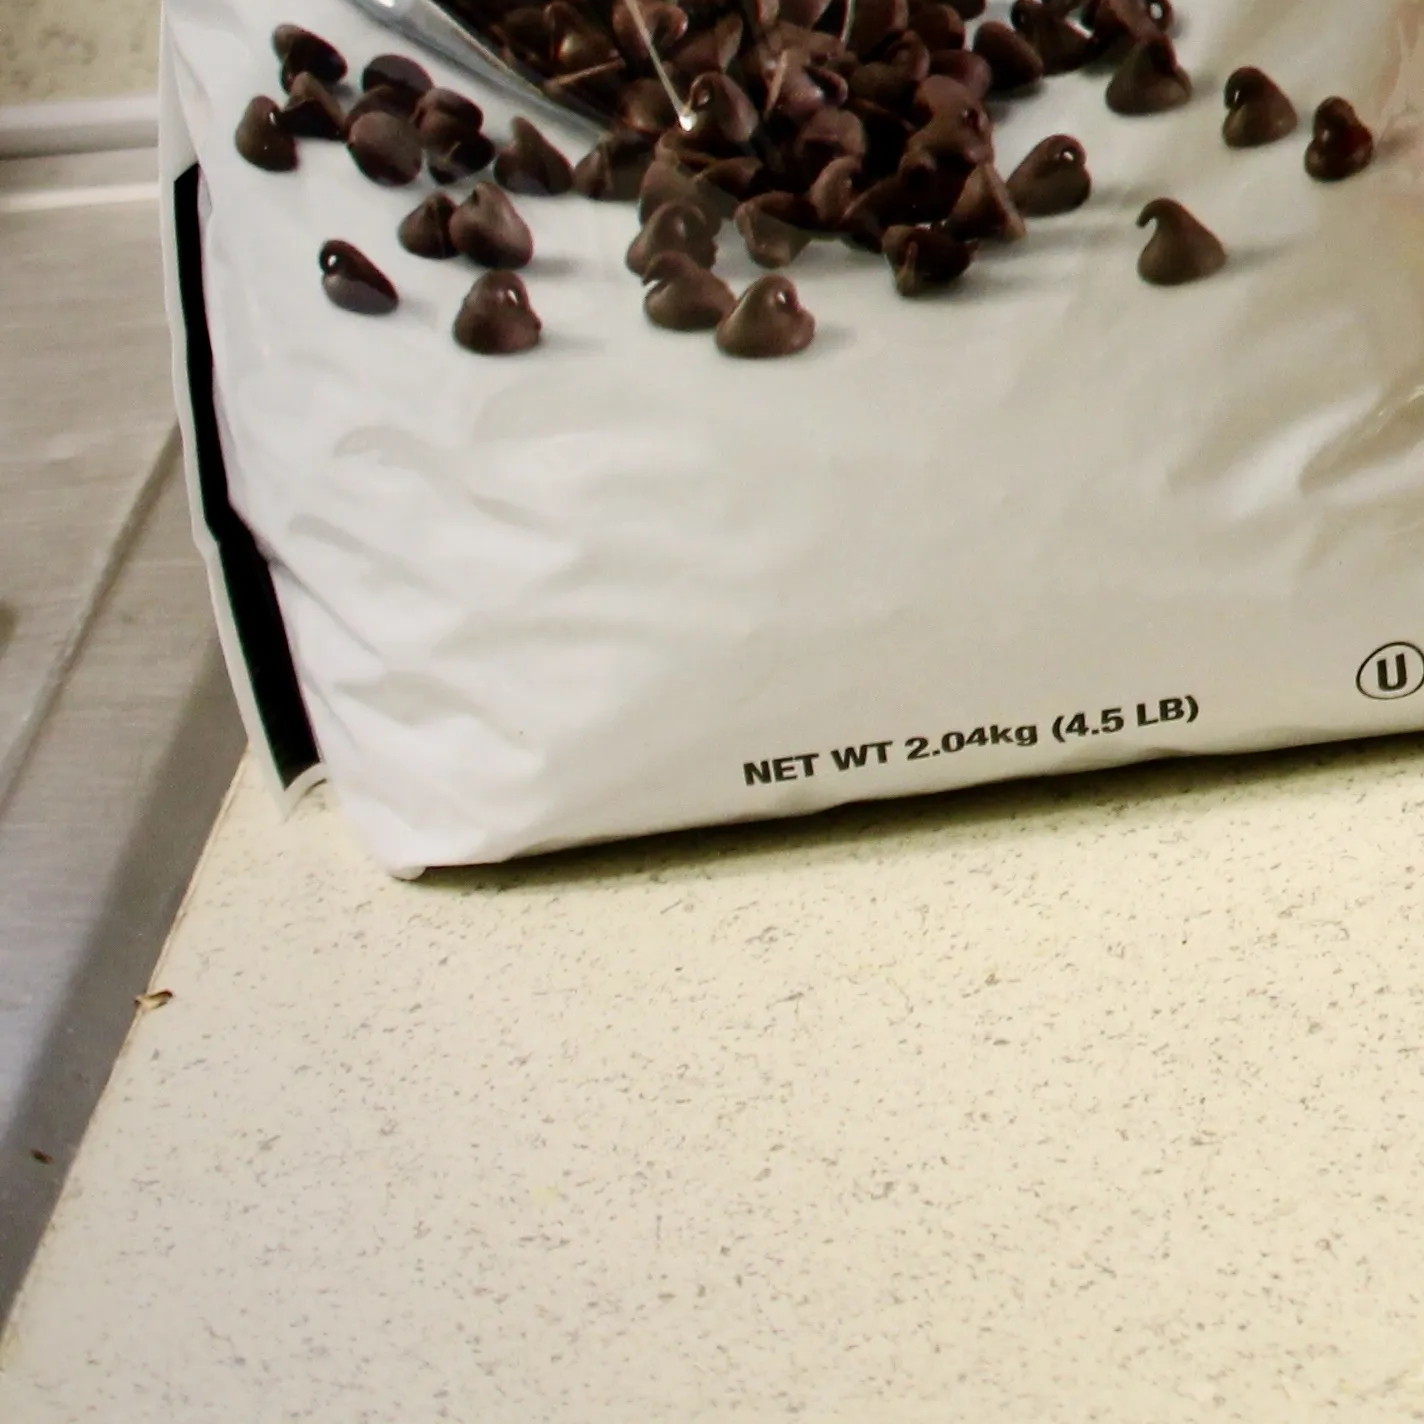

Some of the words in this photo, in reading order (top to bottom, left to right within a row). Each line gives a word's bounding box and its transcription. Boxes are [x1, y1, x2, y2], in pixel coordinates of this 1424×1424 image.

[742, 754, 819, 786] NET
[830, 741, 895, 773] WT
[906, 721, 1038, 761] 2.04kg
[1051, 707, 1124, 745] (4.5
[1136, 695, 1200, 729] LB)
